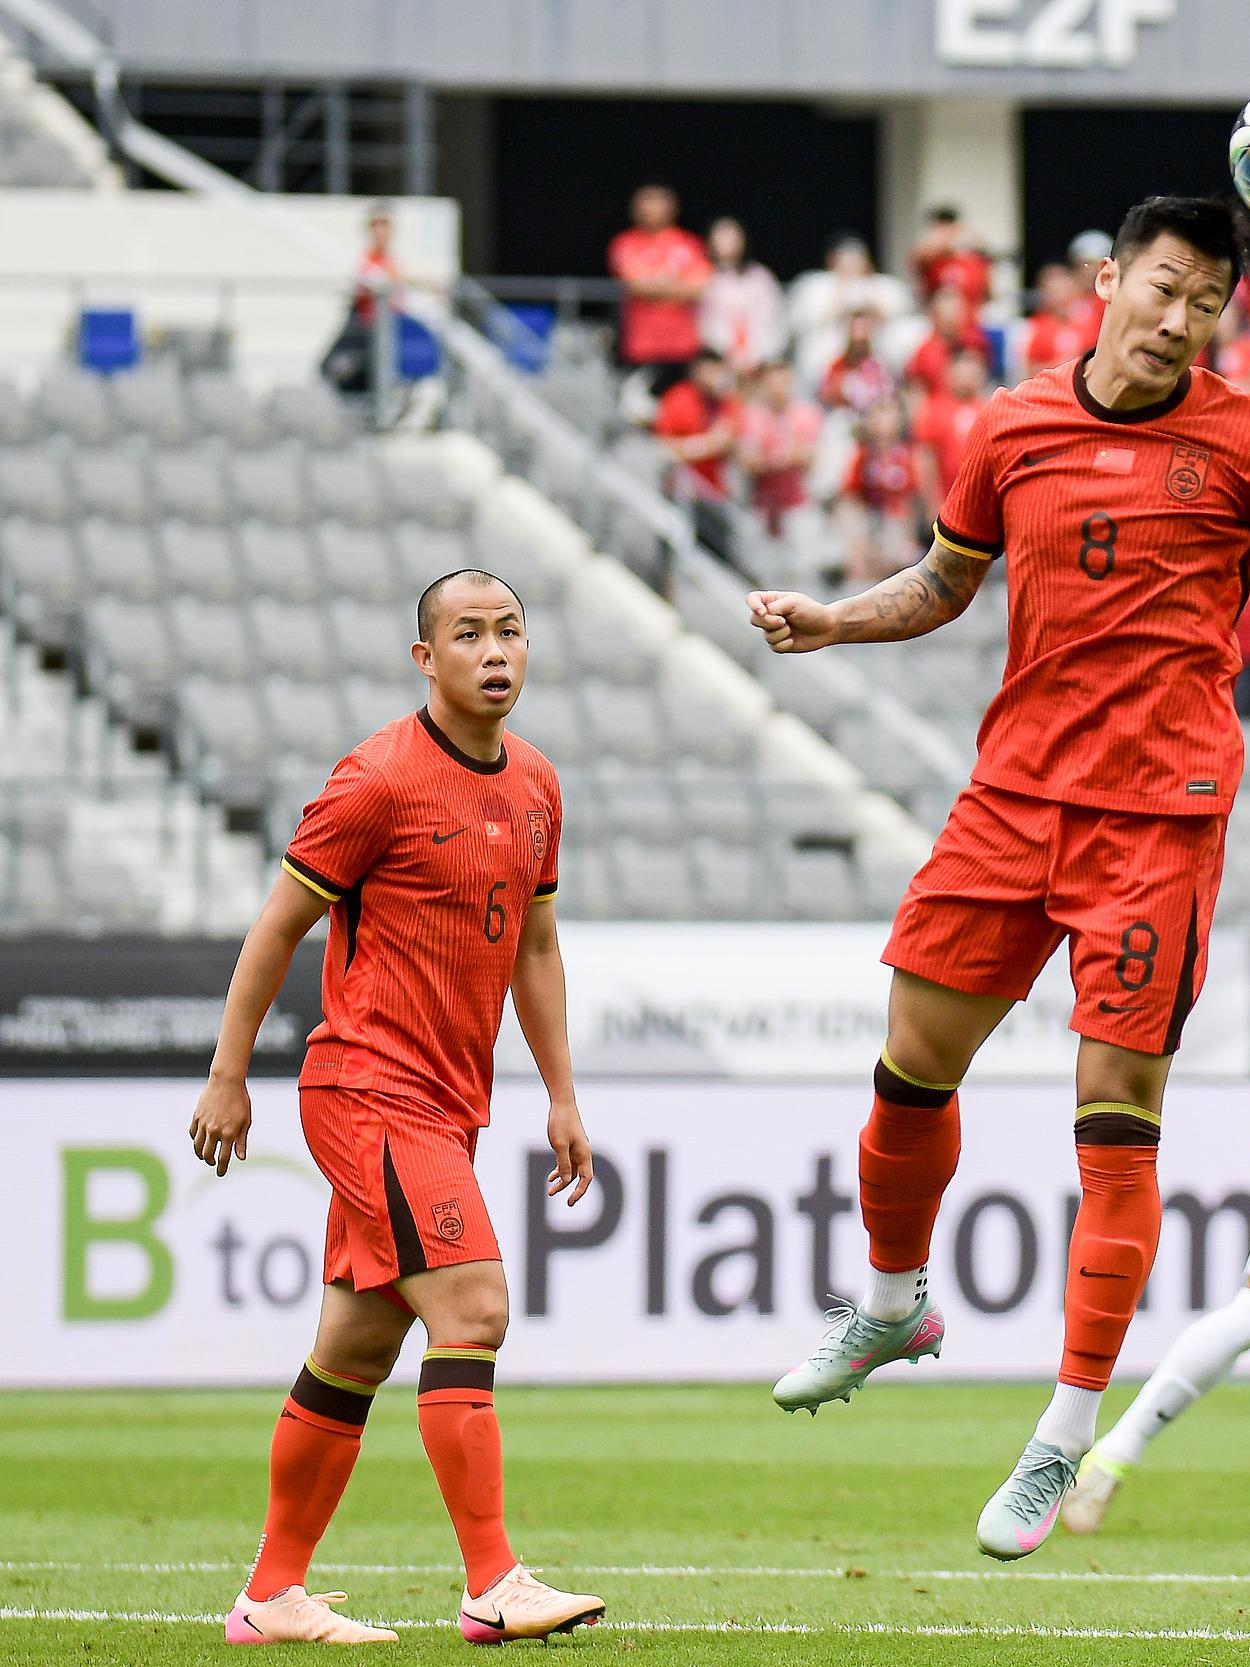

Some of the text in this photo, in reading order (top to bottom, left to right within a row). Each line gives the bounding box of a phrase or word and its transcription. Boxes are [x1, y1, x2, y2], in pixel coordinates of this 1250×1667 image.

[1079, 511, 1119, 581] 8
[484, 881, 507, 944] 6
[1115, 920, 1159, 992] 8
[59, 1147, 175, 1321] B
[211, 1216, 311, 1308] to
